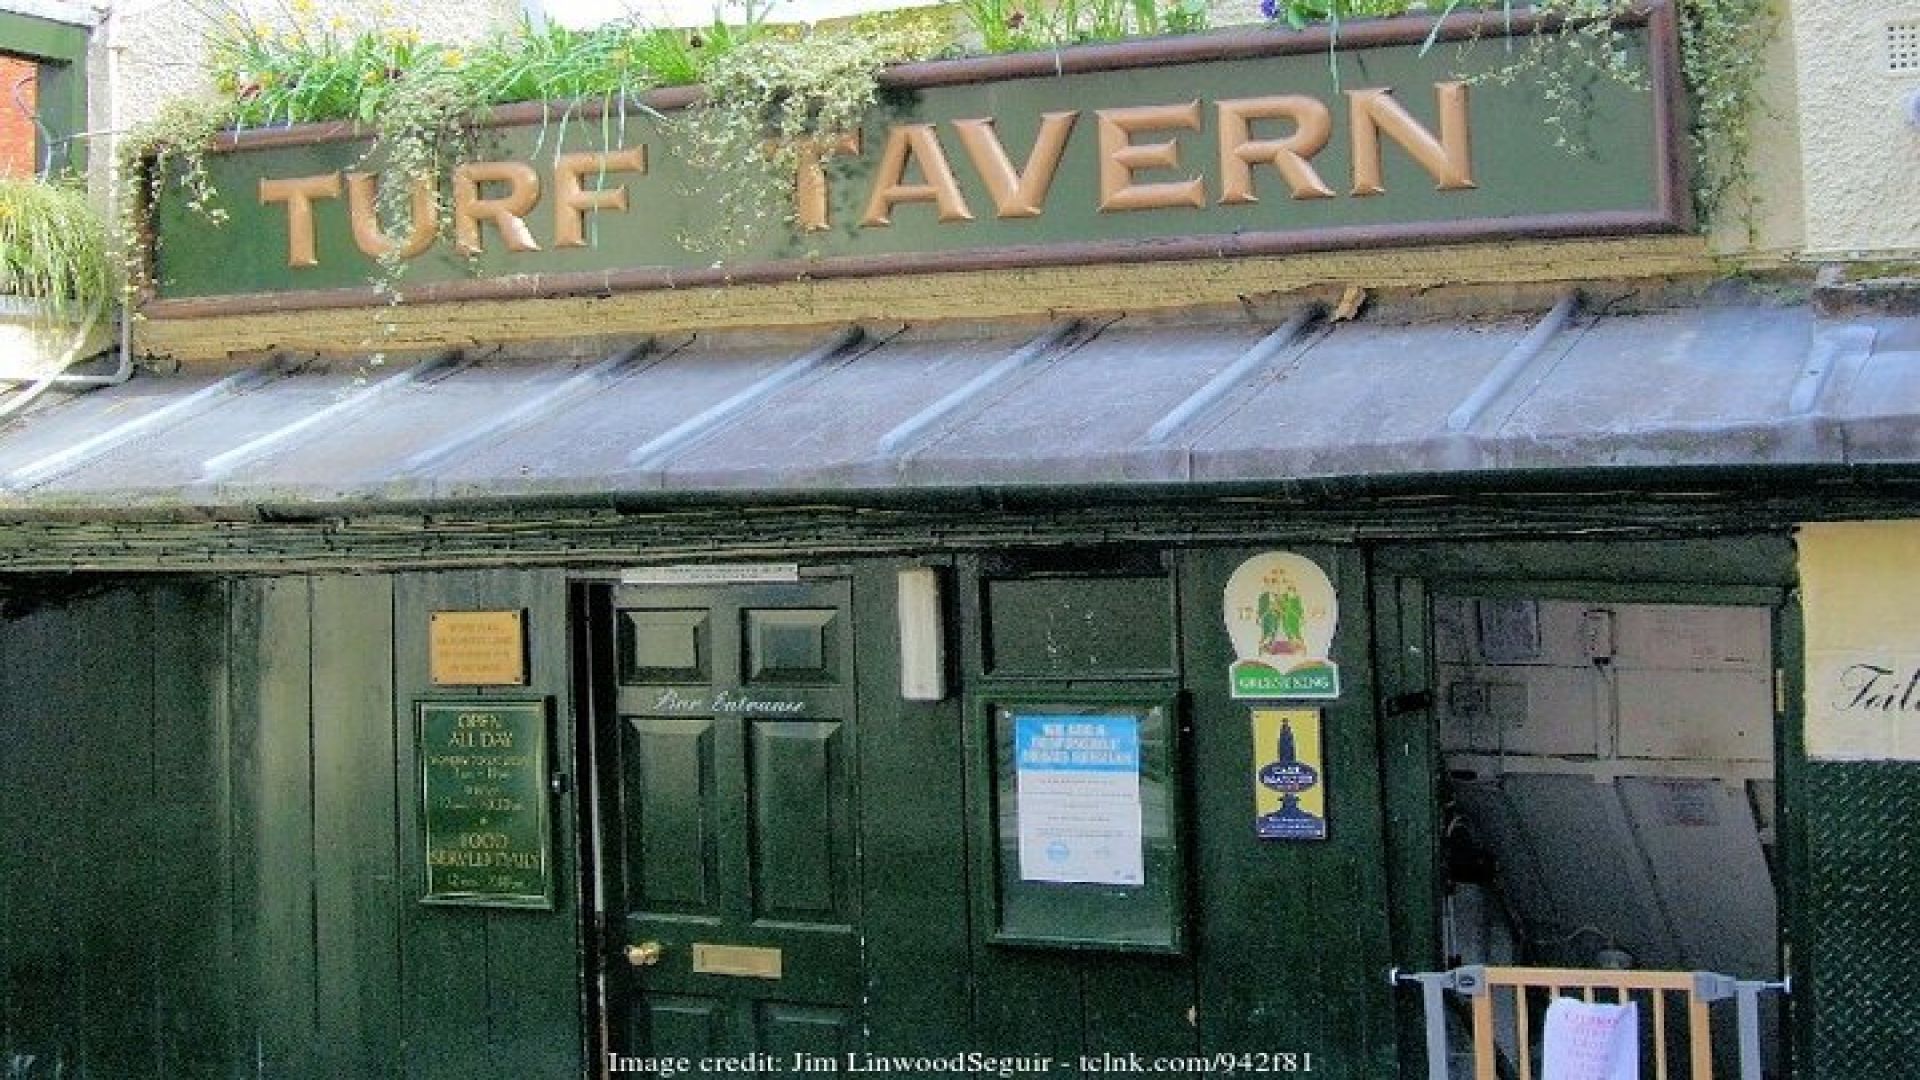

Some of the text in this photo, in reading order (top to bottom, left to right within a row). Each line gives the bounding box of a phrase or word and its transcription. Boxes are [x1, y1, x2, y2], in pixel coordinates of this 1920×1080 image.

[259, 80, 1478, 267] TURF TAVERN
[1832, 664, 1920, 711] Toil
[458, 713, 501, 728] OPEN
[448, 731, 513, 747] ALL DAY
